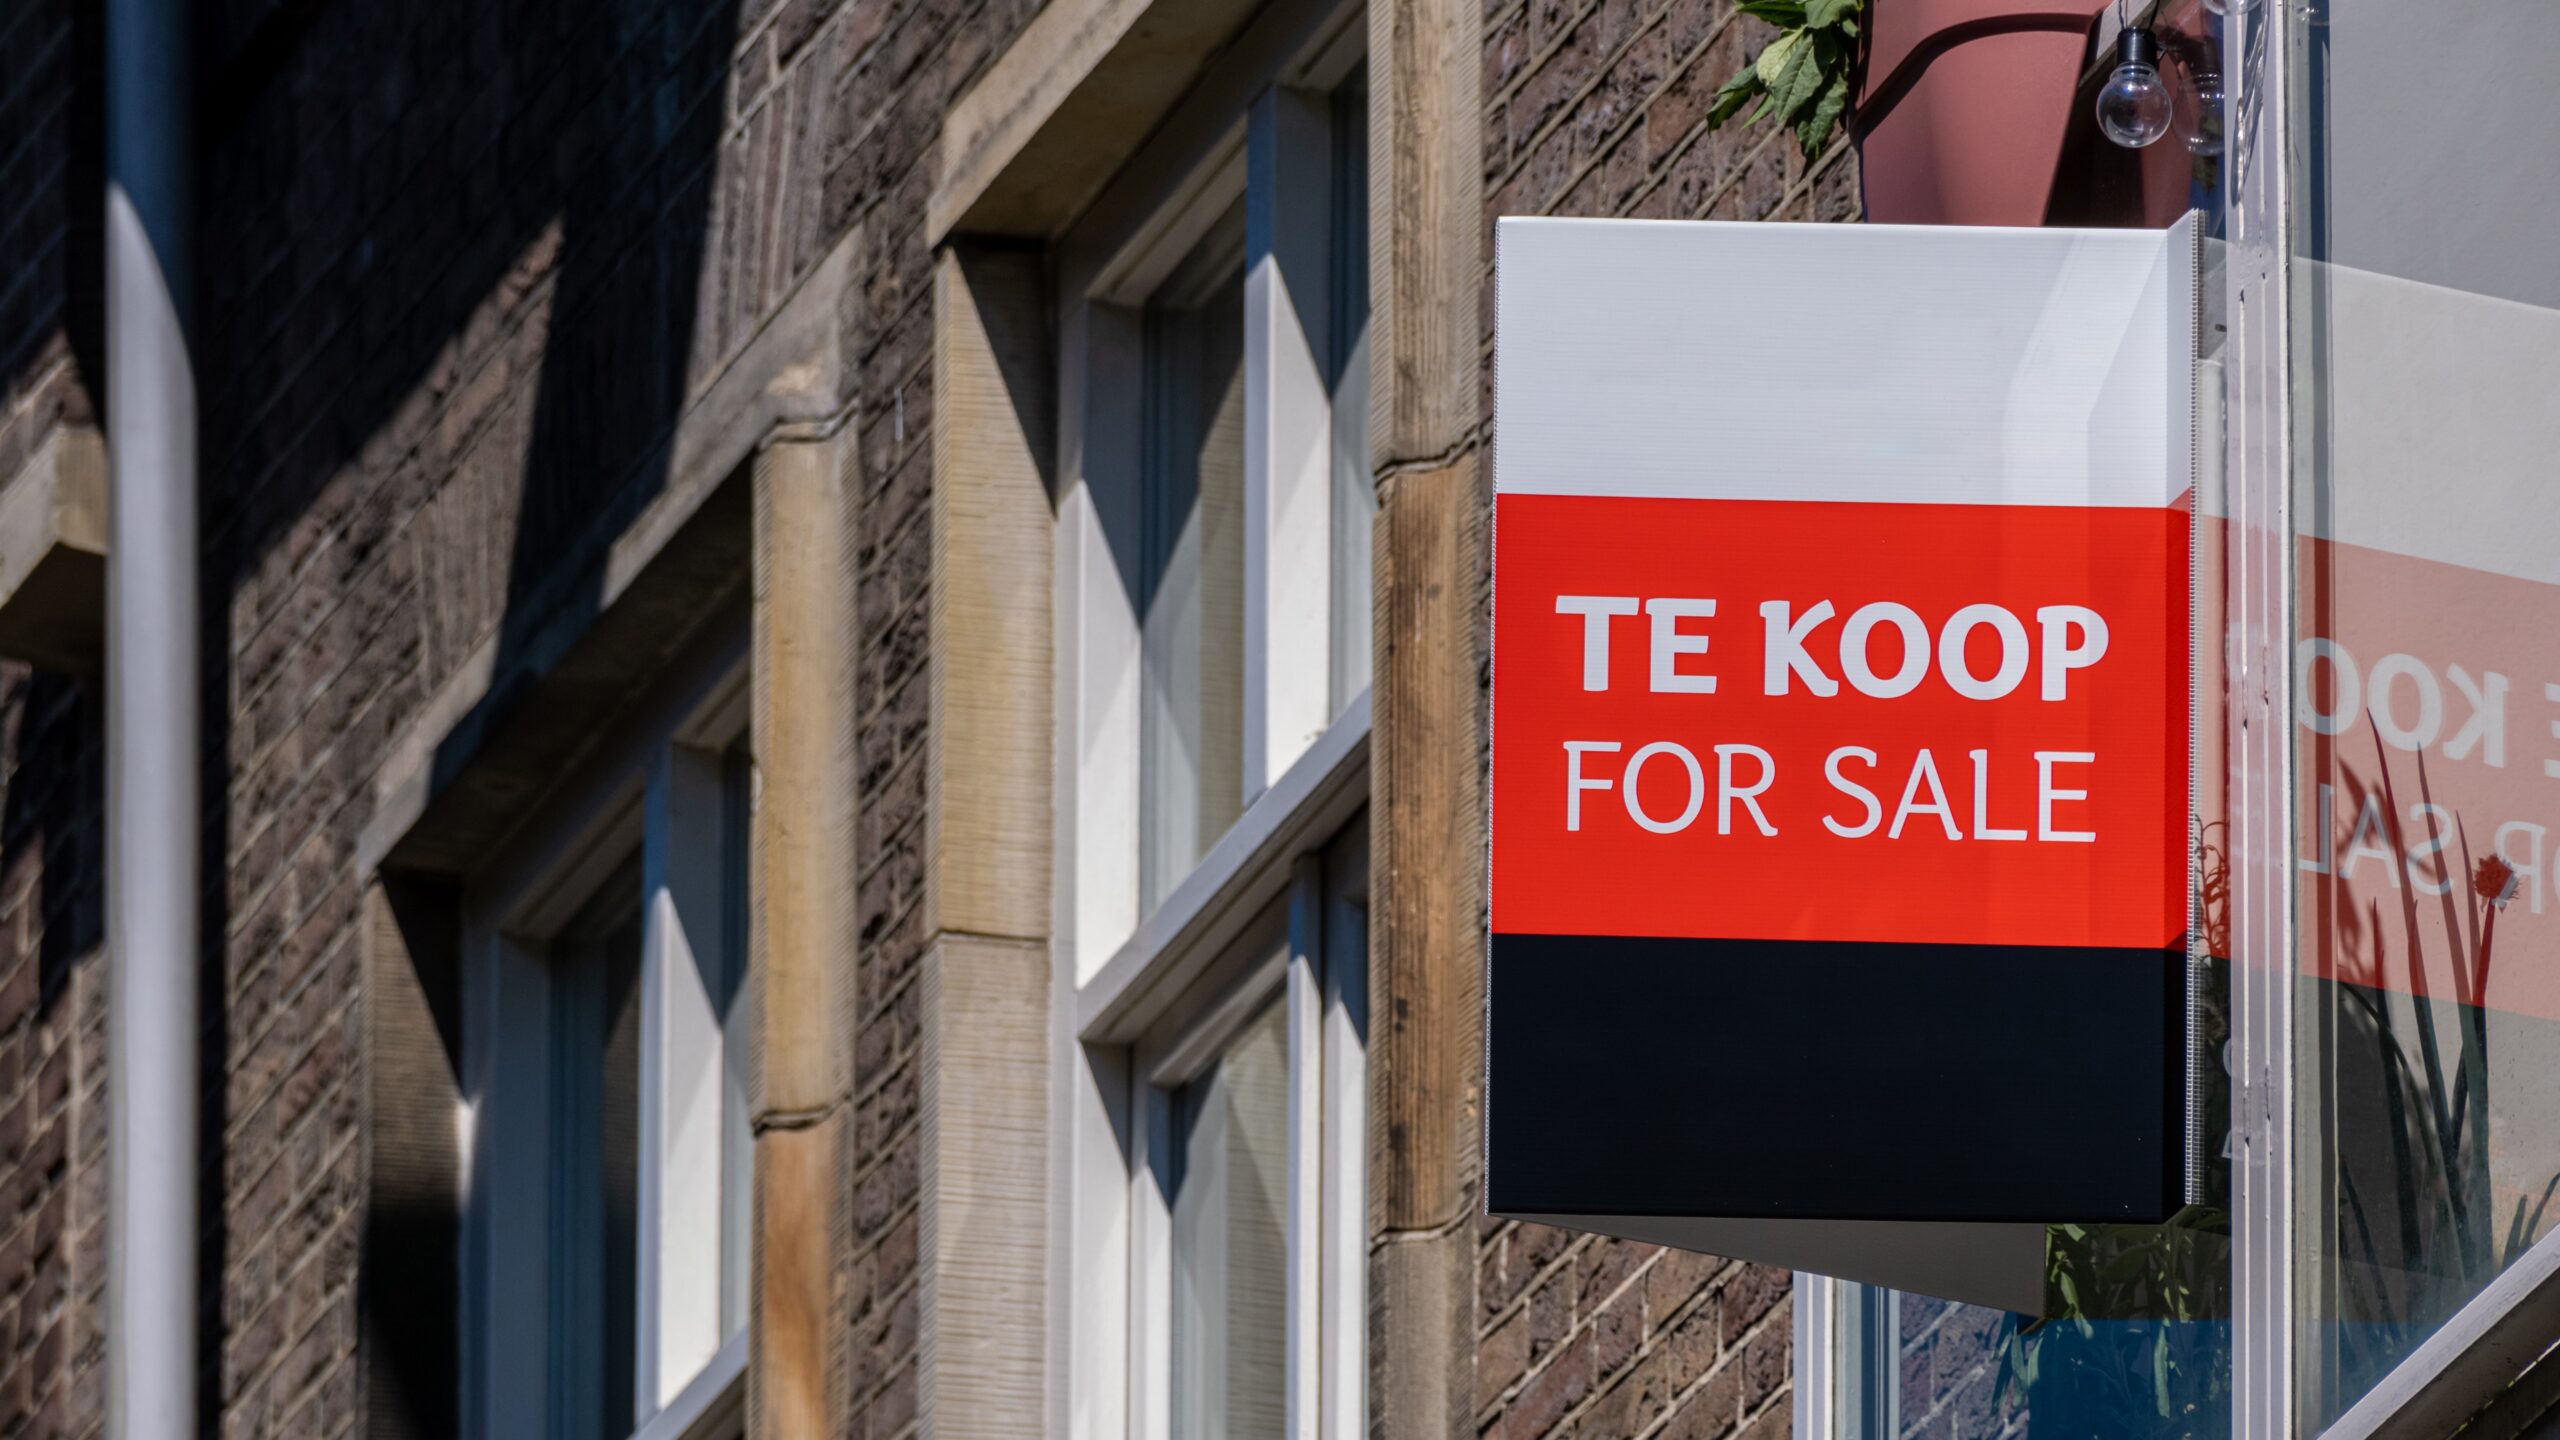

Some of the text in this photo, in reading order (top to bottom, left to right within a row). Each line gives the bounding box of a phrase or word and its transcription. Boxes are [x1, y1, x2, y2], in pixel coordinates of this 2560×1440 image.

[1556, 596, 2108, 701] TE KOOP
[1564, 741, 2095, 842] FOR SALE
